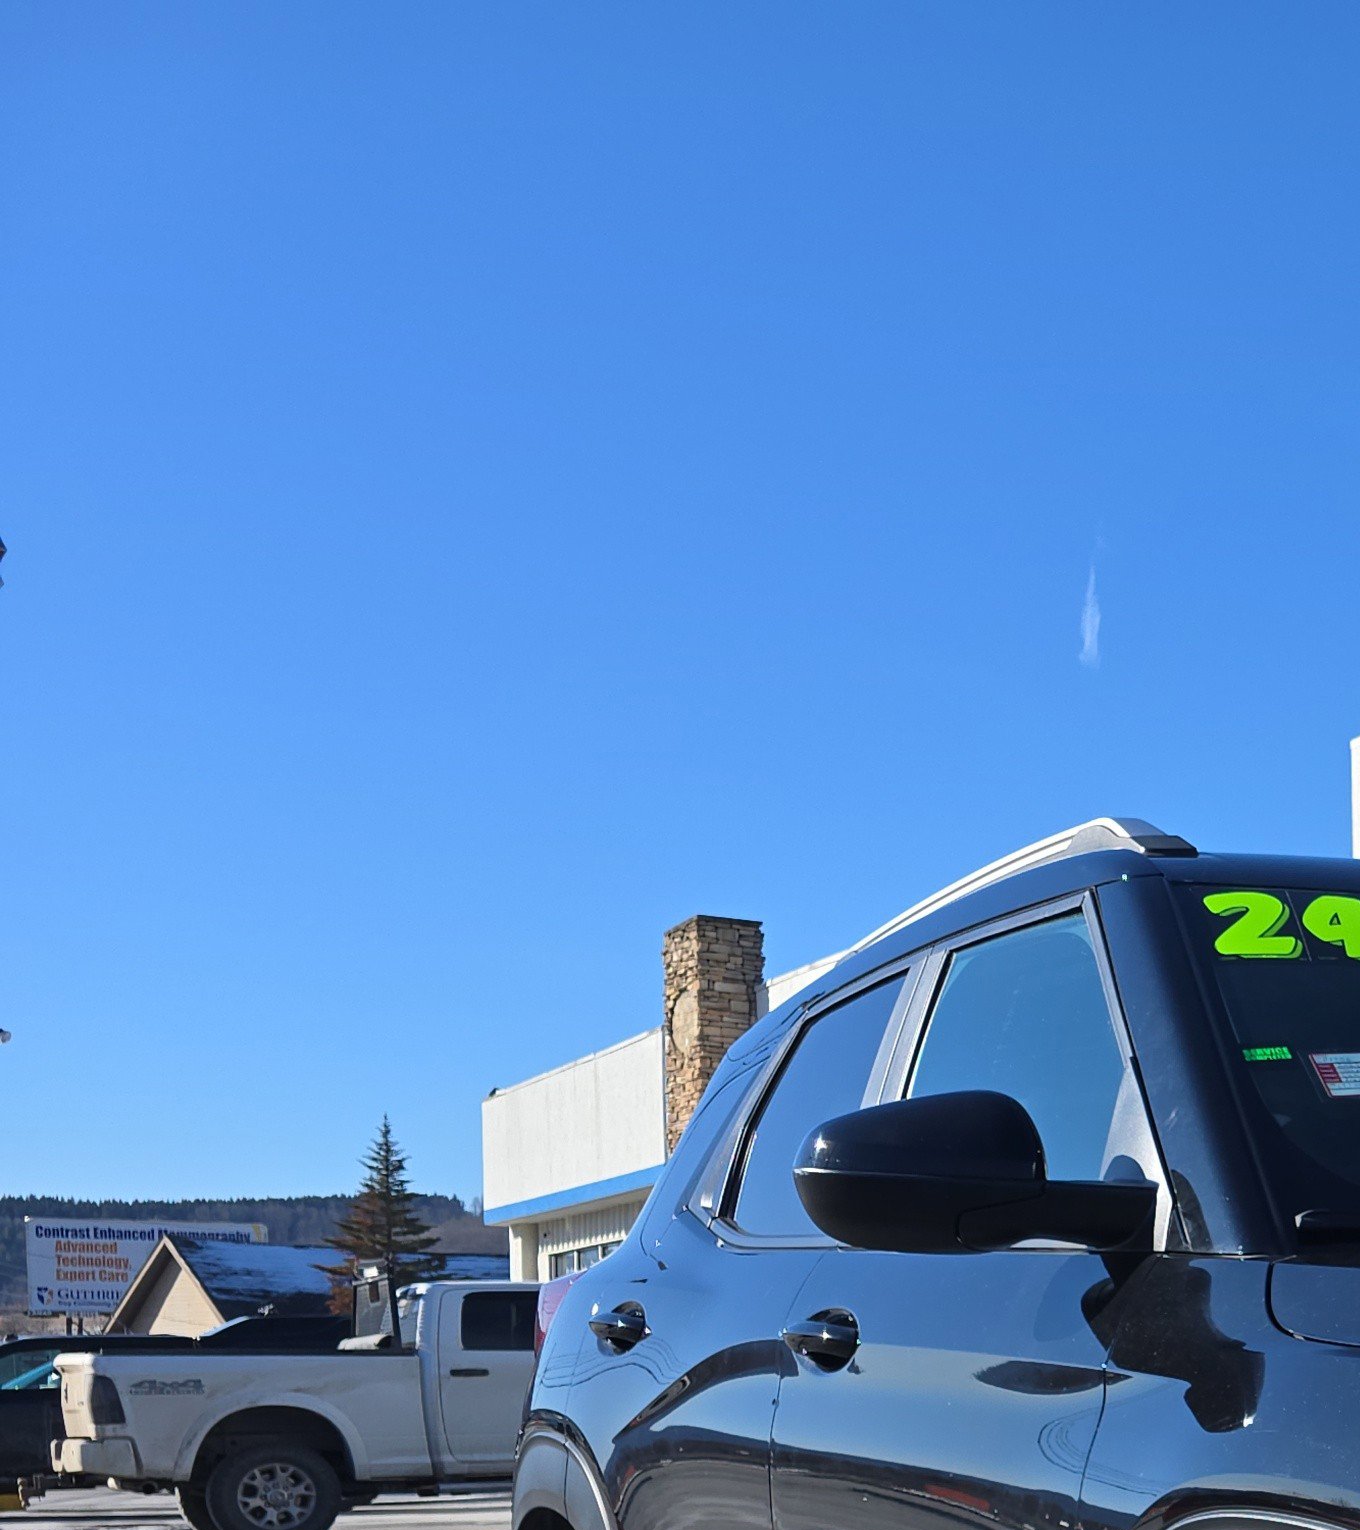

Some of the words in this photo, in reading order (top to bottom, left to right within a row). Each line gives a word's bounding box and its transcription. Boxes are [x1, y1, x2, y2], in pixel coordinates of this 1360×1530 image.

[35, 1225, 92, 1239] Contrast
[93, 1226, 155, 1240] Enhanced
[55, 1241, 117, 1254] Advanced
[56, 1254, 132, 1270] Technology,
[56, 1269, 96, 1283] Expert
[98, 1269, 129, 1283] Care
